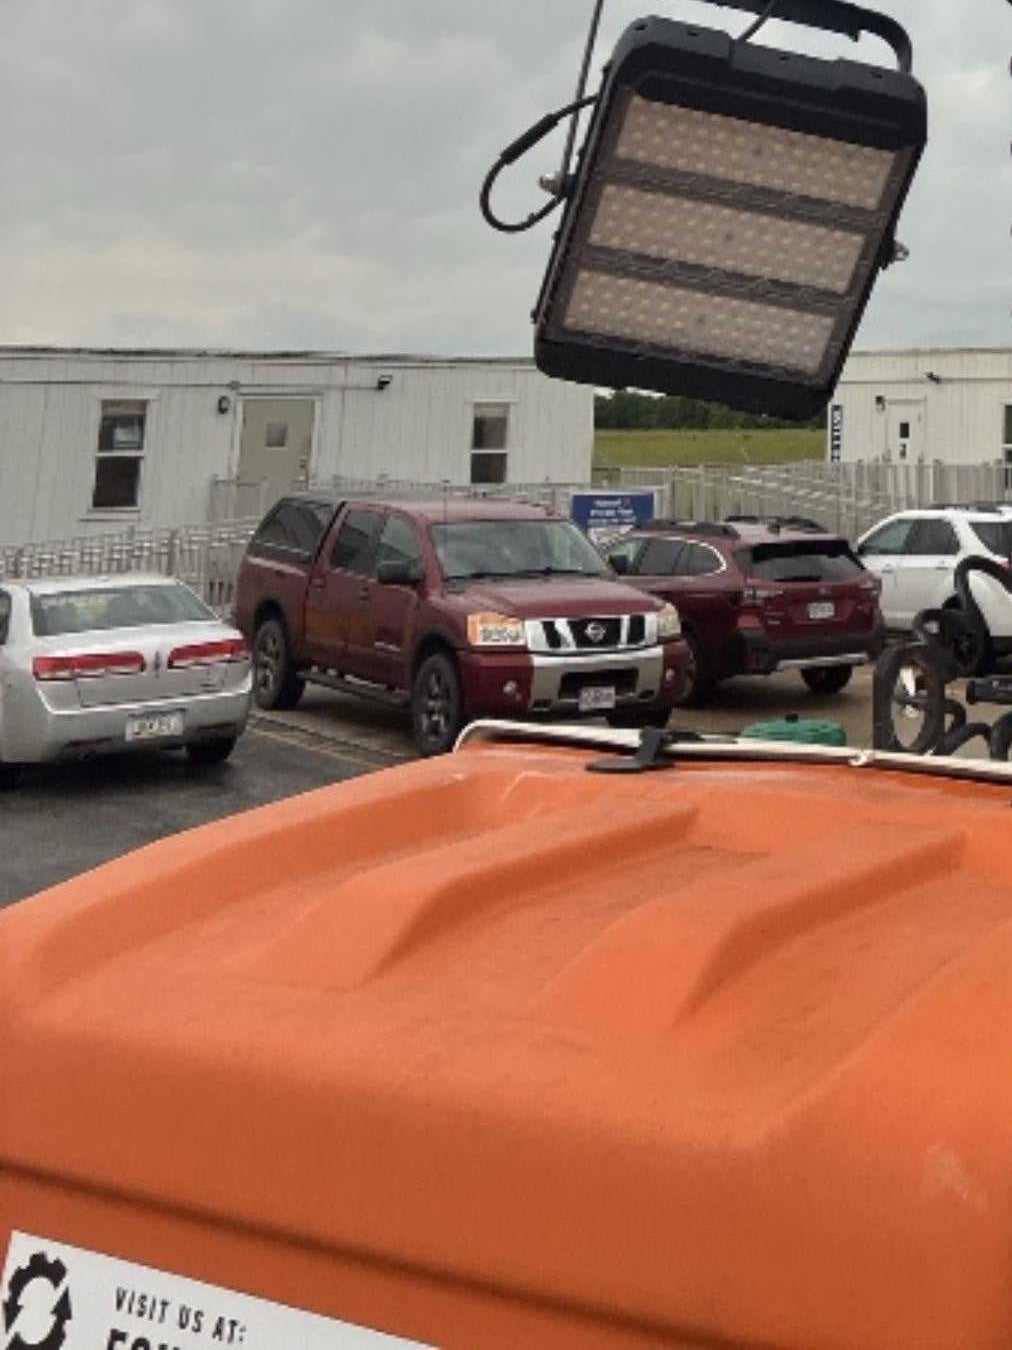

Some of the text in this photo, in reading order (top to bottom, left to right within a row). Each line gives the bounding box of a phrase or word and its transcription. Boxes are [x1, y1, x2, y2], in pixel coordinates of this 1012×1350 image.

[116, 1286, 171, 1324] VISIT
[178, 1304, 204, 1333] US
[211, 1316, 247, 1344] AT:
